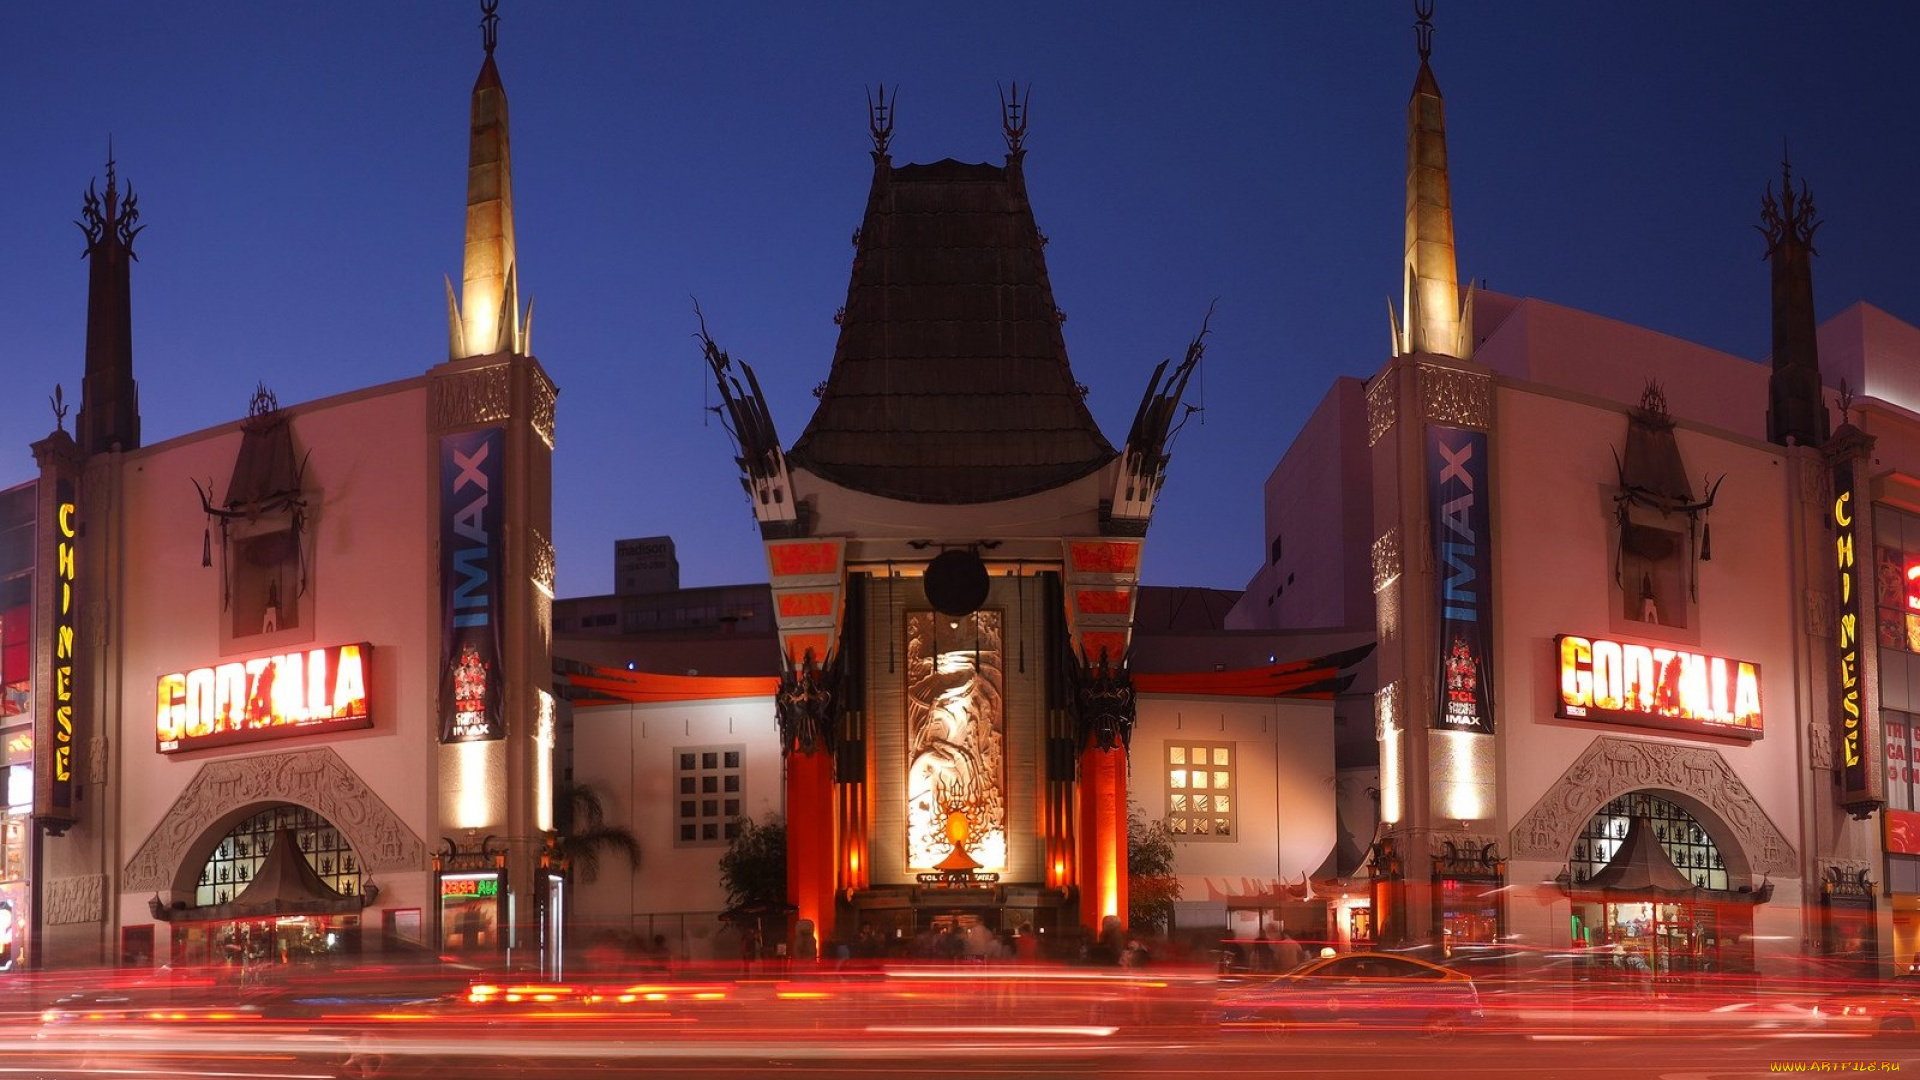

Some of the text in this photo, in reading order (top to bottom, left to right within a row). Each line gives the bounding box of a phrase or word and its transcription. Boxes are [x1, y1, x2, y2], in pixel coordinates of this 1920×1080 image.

[453, 440, 489, 628] IMAX
[1439, 440, 1477, 622] IMAX
[56, 502, 75, 782] CHINESE
[1835, 491, 1859, 768] CHINESE
[453, 724, 489, 736] IMAX
[456, 700, 485, 711] TCL
[1446, 714, 1481, 726] IMAX
[1448, 691, 1476, 702] TCL
